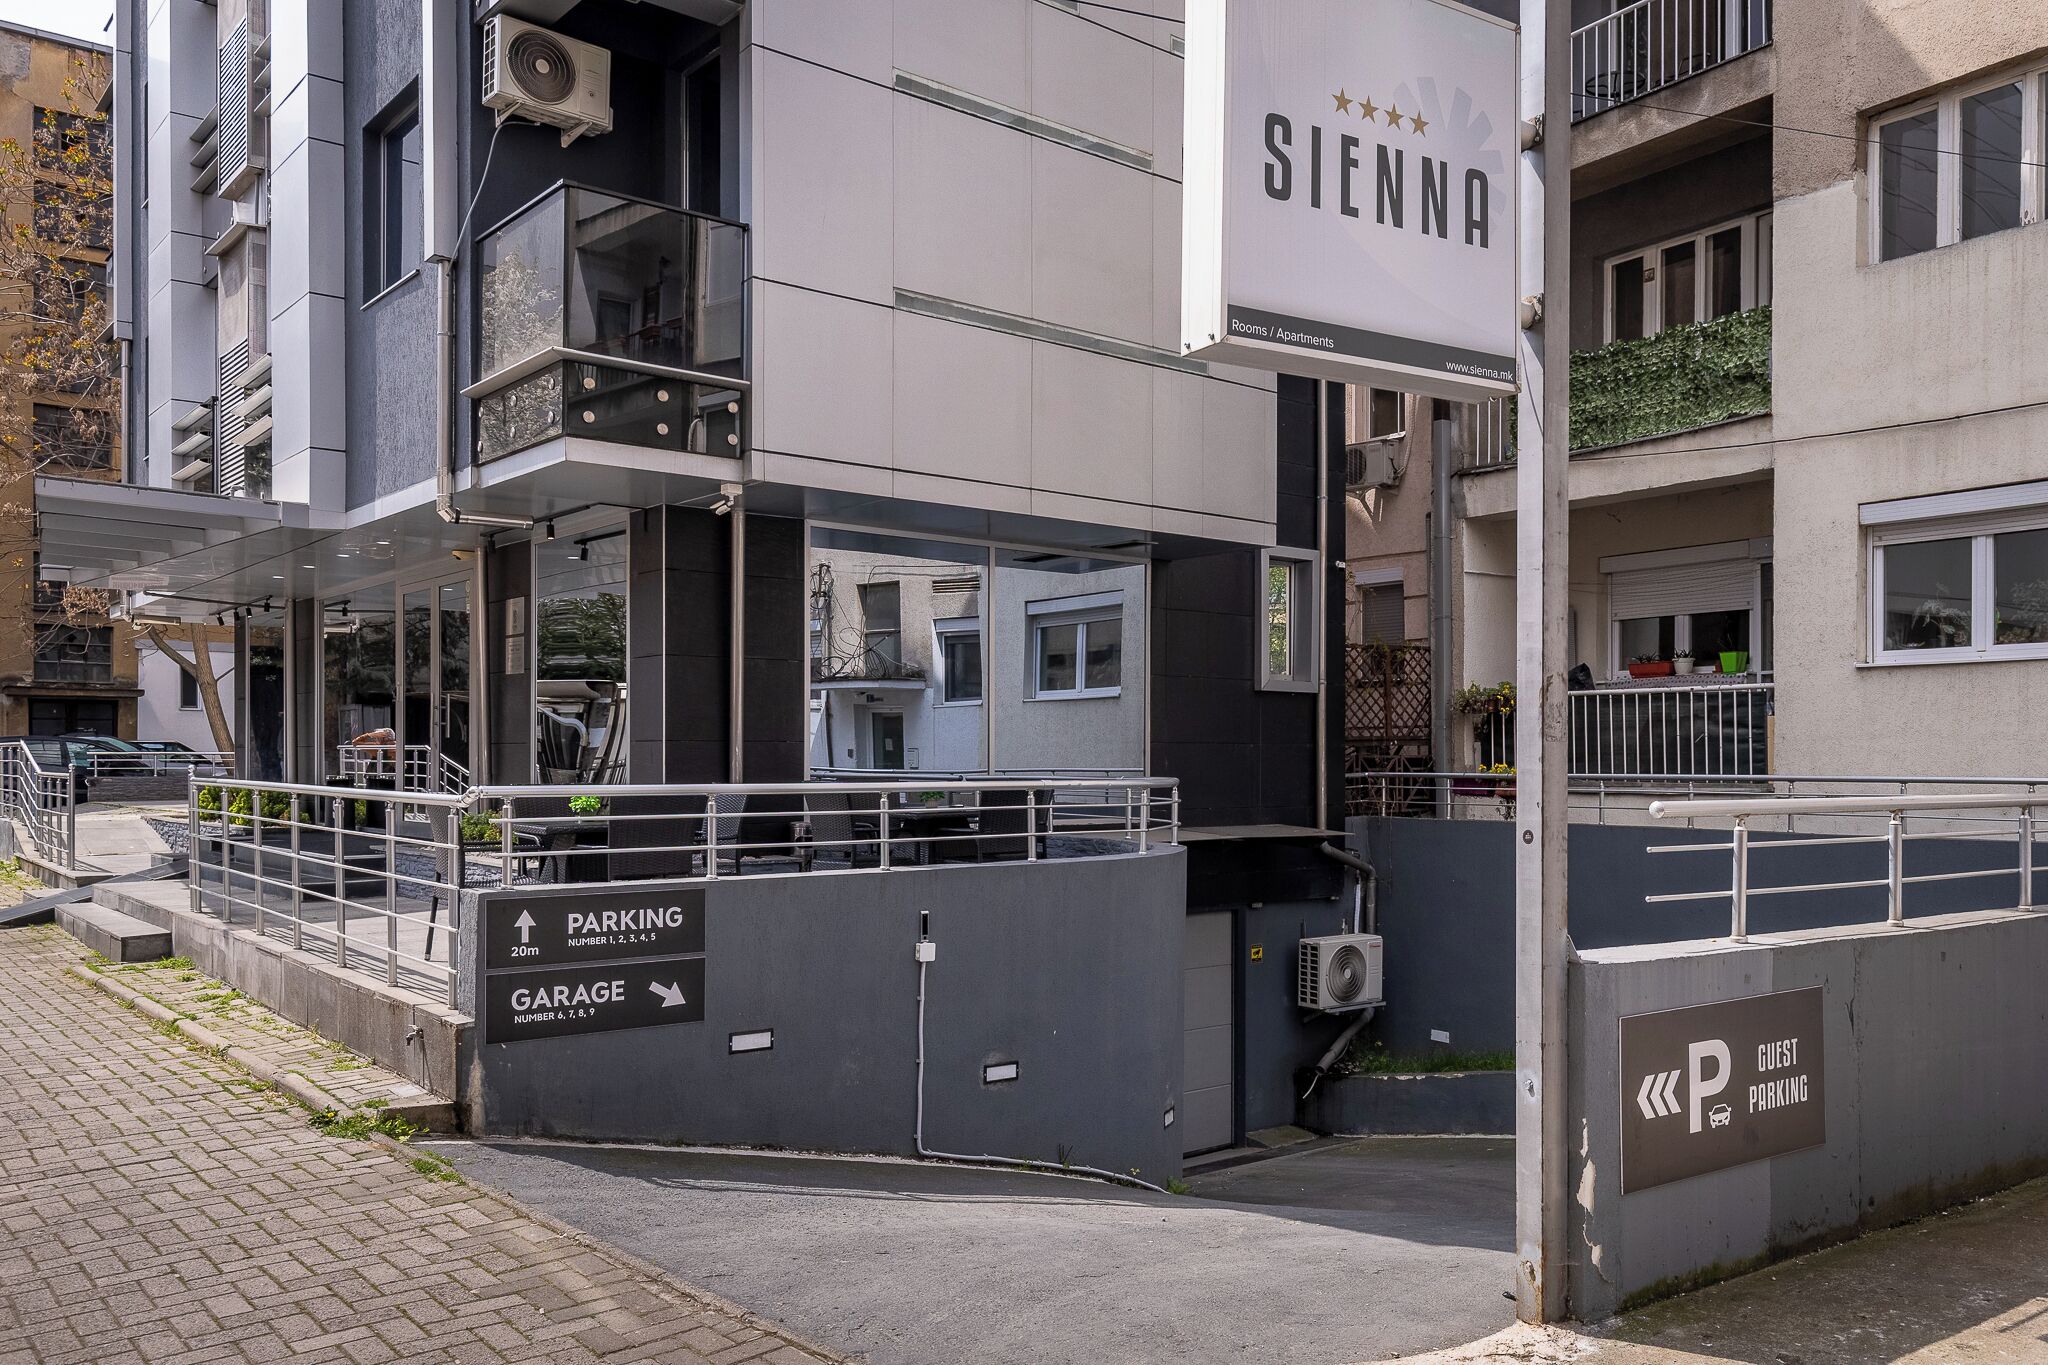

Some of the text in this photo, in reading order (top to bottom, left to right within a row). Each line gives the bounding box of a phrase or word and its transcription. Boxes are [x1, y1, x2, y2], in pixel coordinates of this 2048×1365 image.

[1264, 112, 1489, 249] SIENNA
[1232, 318, 1335, 348] Rooms / Apartments
[1445, 361, 1514, 381] www.sienna.mk
[567, 906, 683, 935] PARKING
[511, 945, 539, 957] 20m
[568, 932, 656, 947] NUMBER 1, 2, 3, 4, 5
[511, 980, 625, 1011] GARAGE
[514, 1007, 595, 1024] NUMBER 6, 7, 8, 9
[1758, 1037, 1798, 1073] GUEST
[1688, 1039, 1732, 1134] P
[1749, 1074, 1808, 1114] PARKING
